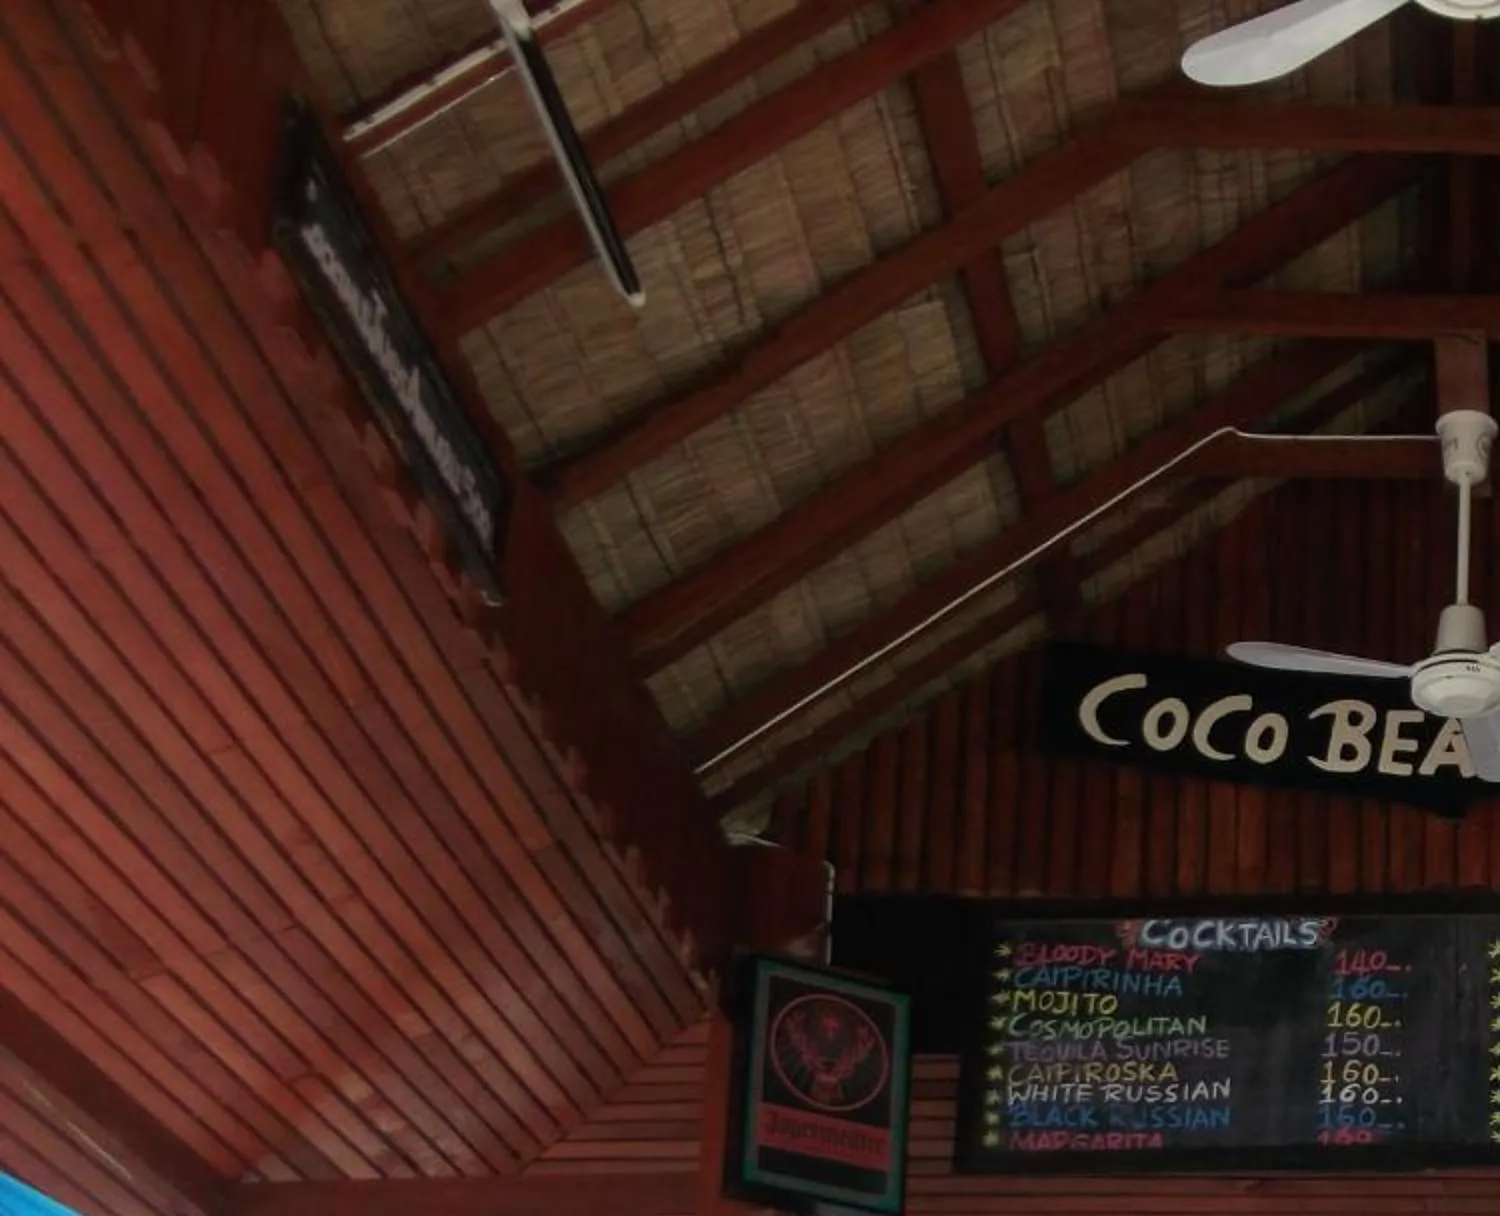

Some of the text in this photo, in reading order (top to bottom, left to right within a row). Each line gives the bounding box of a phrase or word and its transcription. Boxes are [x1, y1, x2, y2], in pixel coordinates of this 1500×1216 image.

[1079, 673, 1288, 765] COCO
[1141, 918, 1327, 951] COCKTAILS
[1013, 942, 1117, 967] BLOODY
[1128, 947, 1203, 974] MARY
[1014, 967, 1184, 998] CAIPIRINHA
[1010, 991, 1118, 1016] MOJITO
[1008, 1012, 1207, 1041] COSMOPOLITAN
[1005, 1041, 1108, 1062] TEQUILA
[1117, 1039, 1230, 1061] SUNRISE
[1008, 1061, 1178, 1087] CAIPIROSKA
[1007, 1083, 1093, 1105] WHITE
[1104, 1077, 1232, 1104] RUSSIAN
[1009, 1104, 1098, 1128] BLACK
[1108, 1105, 1230, 1128] RUSSIAN
